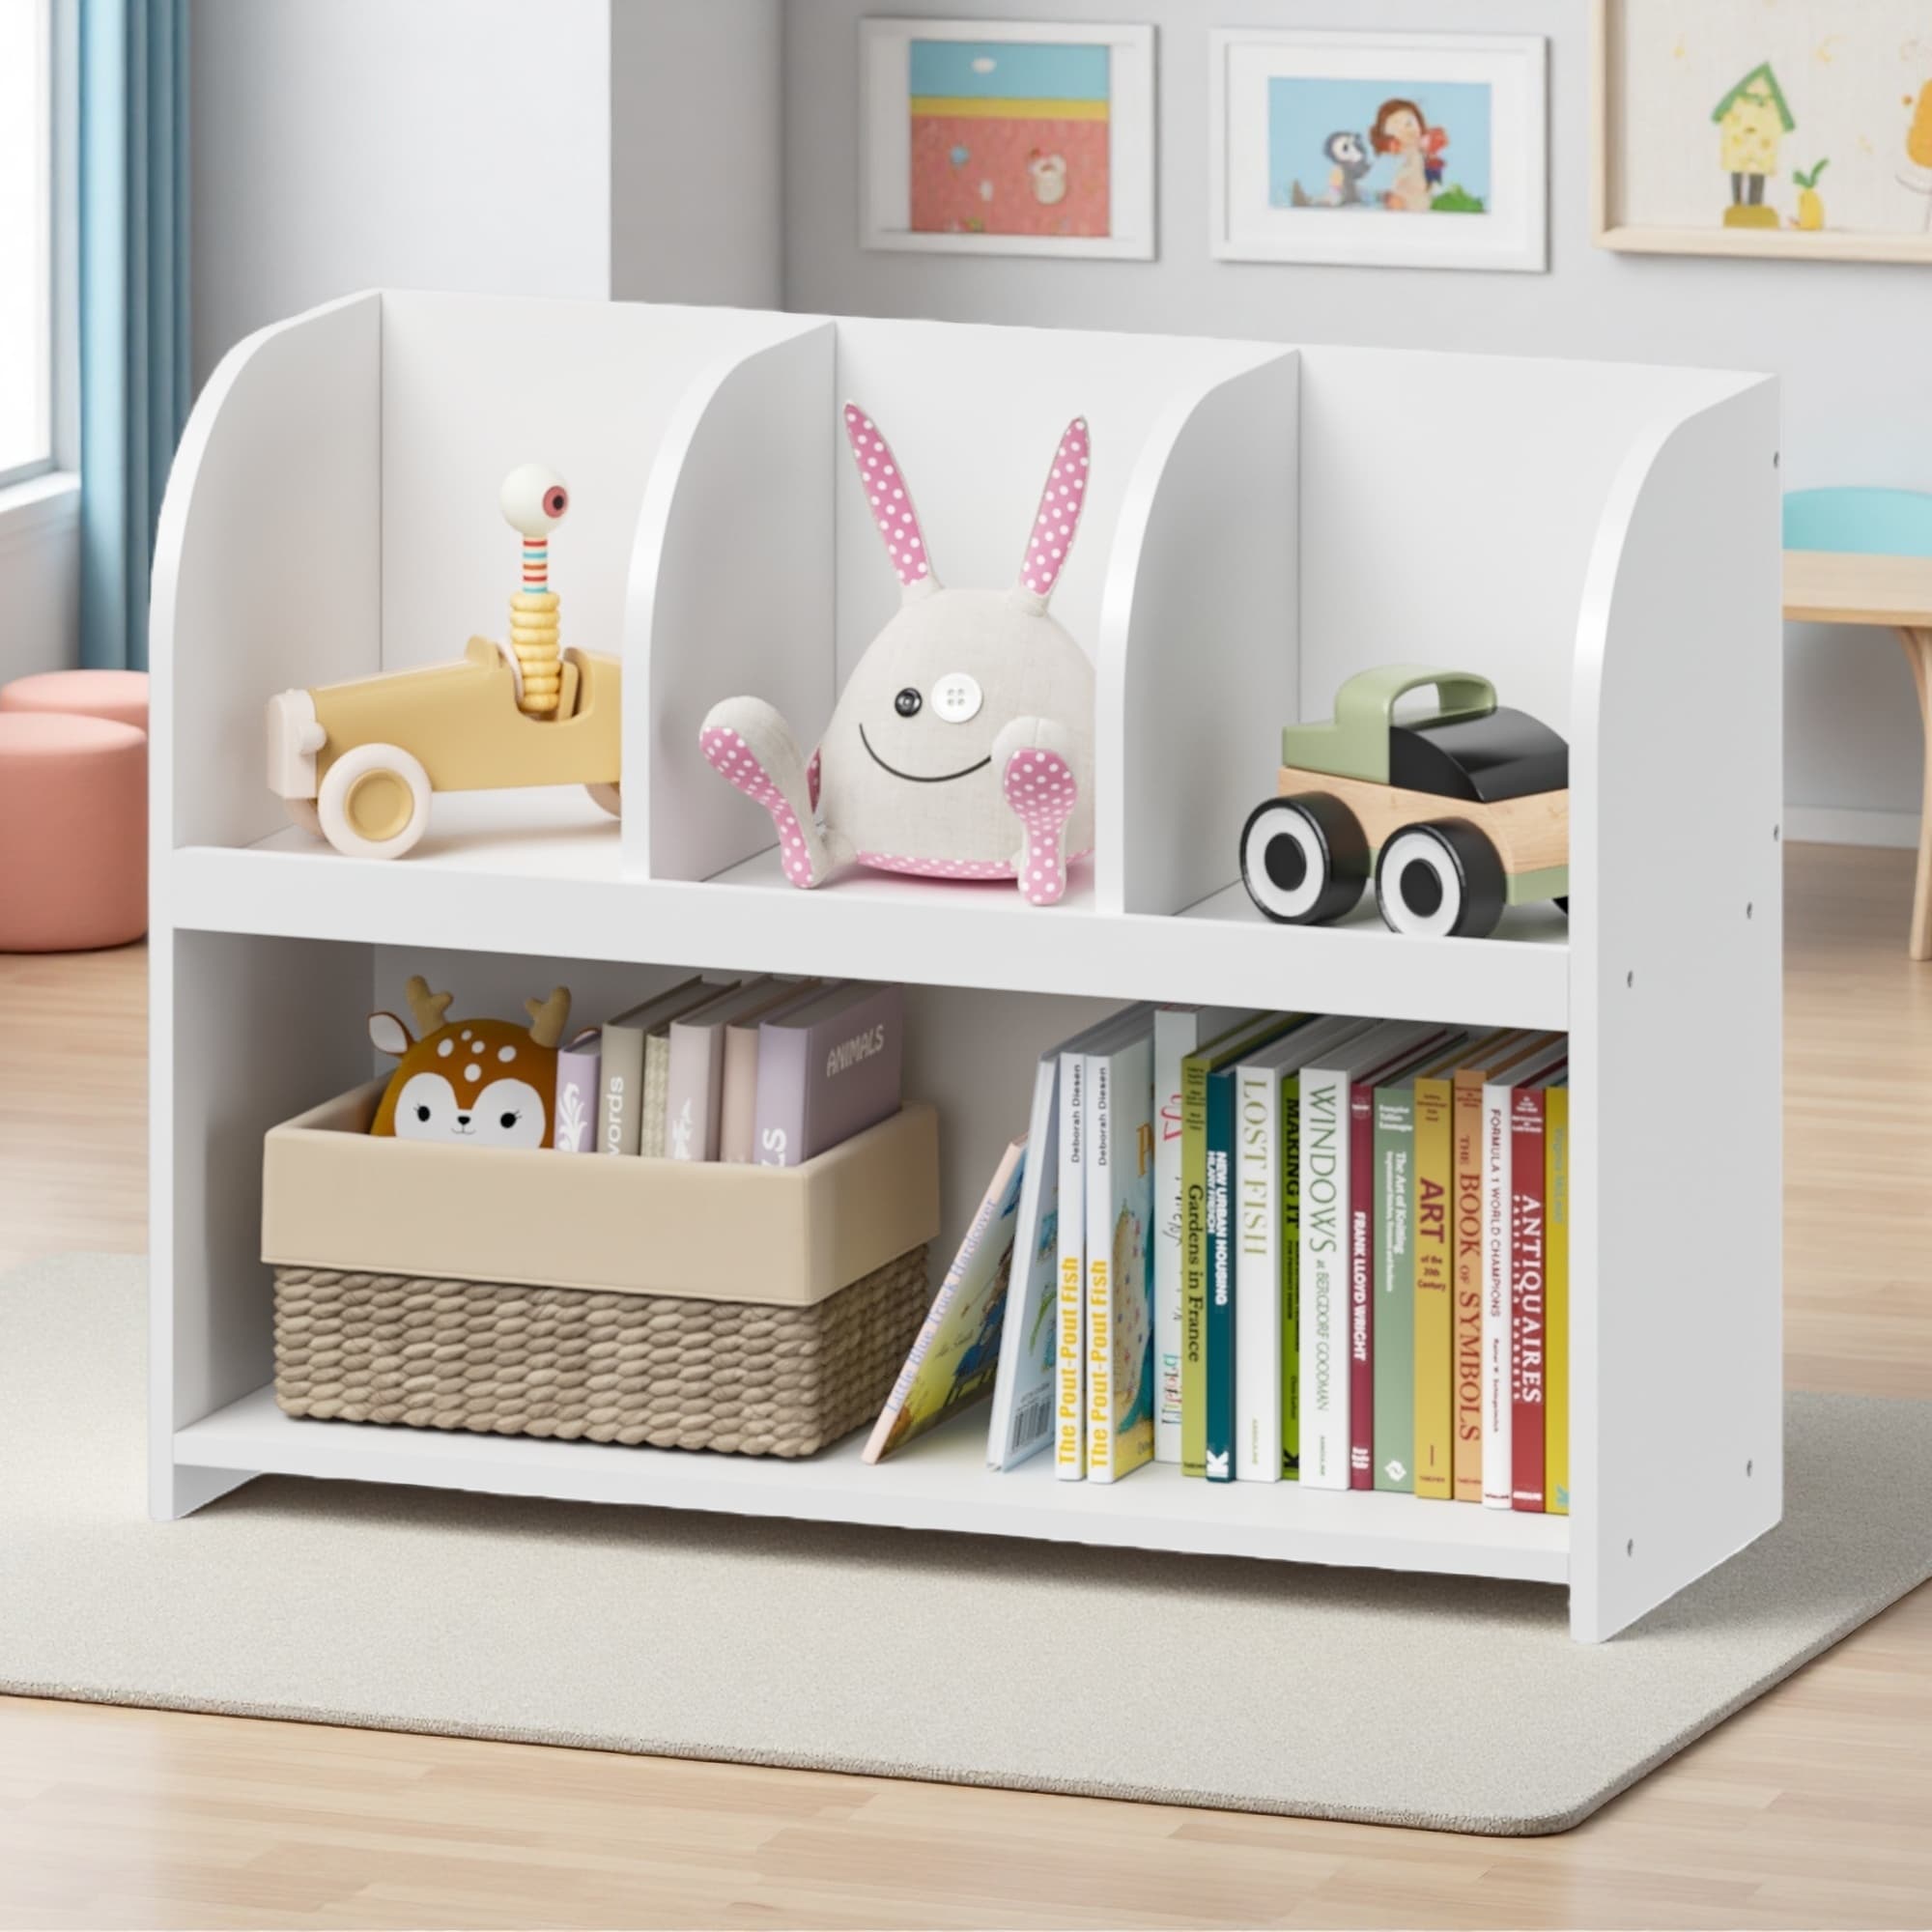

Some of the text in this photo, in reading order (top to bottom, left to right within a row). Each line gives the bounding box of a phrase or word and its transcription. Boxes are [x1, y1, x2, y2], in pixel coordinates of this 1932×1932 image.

[826, 1024, 885, 1077] ANIMALS
[1071, 1065, 1082, 1163] Deborah Diesen
[1097, 1067, 1107, 1166] Deborah Diesen
[1286, 1098, 1299, 1197] MAKING
[1491, 1109, 1501, 1172] FORMULA
[1242, 1080, 1267, 1256] LOST FISH
[1286, 1204, 1299, 1229] IT
[1309, 1085, 1338, 1253] WINDOWS
[1394, 1151, 1406, 1255] The Art of Knitting
[1420, 1177, 1444, 1244] ART
[1491, 1187, 1500, 1236] WORLD
[1188, 1184, 1204, 1363] Gardens in France
[1215, 1151, 1227, 1306] NEW URBAN HOUSING
[1431, 1255, 1442, 1264] the
[886, 1198, 998, 1414] Little Blue Truck Hardcover
[1316, 1272, 1330, 1340] BERGDORF
[1353, 1211, 1367, 1361] FRANK LLOYD WRIGHT
[1417, 1280, 1446, 1292] Century
[1460, 1135, 1481, 1441] THE BOOK OF SYMBOLS
[1491, 1239, 1500, 1318] CHAMPIONS
[1519, 1194, 1542, 1403] ANTIQUAIRES
[1059, 1257, 1079, 1466] The Pout-Pout Fish
[1090, 1261, 1108, 1468] The Pout-Pout Fish
[1316, 1342, 1329, 1411] GOODMAN
